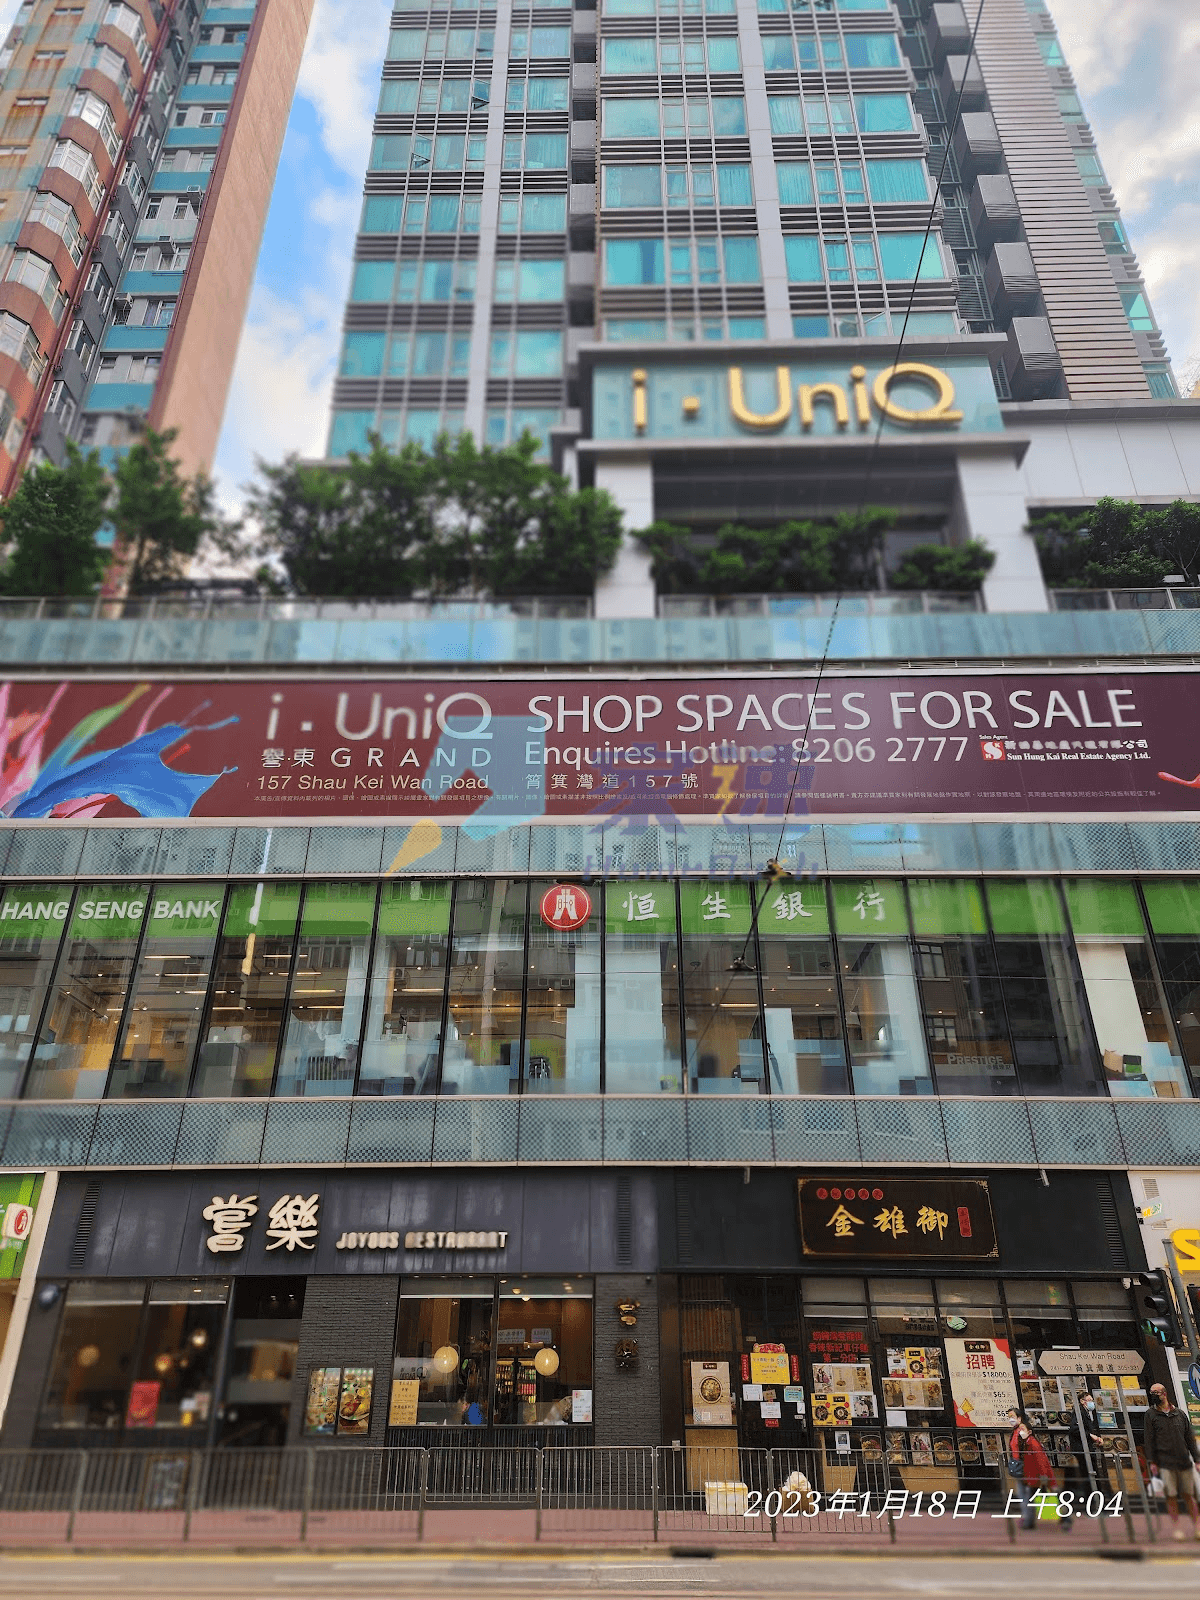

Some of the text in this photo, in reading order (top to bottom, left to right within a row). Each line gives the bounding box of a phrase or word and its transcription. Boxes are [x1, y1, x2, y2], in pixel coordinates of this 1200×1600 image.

[727, 362, 964, 430] UniQ
[335, 692, 493, 741] UniQ
[526, 694, 663, 734] SHOP
[676, 692, 870, 733] SPACES
[889, 690, 998, 731] FOR
[1007, 689, 1143, 729] SALE
[330, 747, 492, 768] GRAND
[525, 736, 968, 771] Enquires Hotline: 8206 2777
[1007, 753, 1022, 761] Sun
[1023, 753, 1045, 762] Hung
[1105, 753, 1133, 762] Agency
[1134, 752, 1151, 760] Ltd.
[257, 774, 489, 790] 157 Shau Kei Wan Road
[1, 900, 221, 920] HANG SENG BANK
[621, 890, 887, 923] 恒生銀行
[948, 1053, 1003, 1064] PRESTIGE
[826, 1204, 949, 1240] 金雄御
[966, 1354, 996, 1370] 招聘
